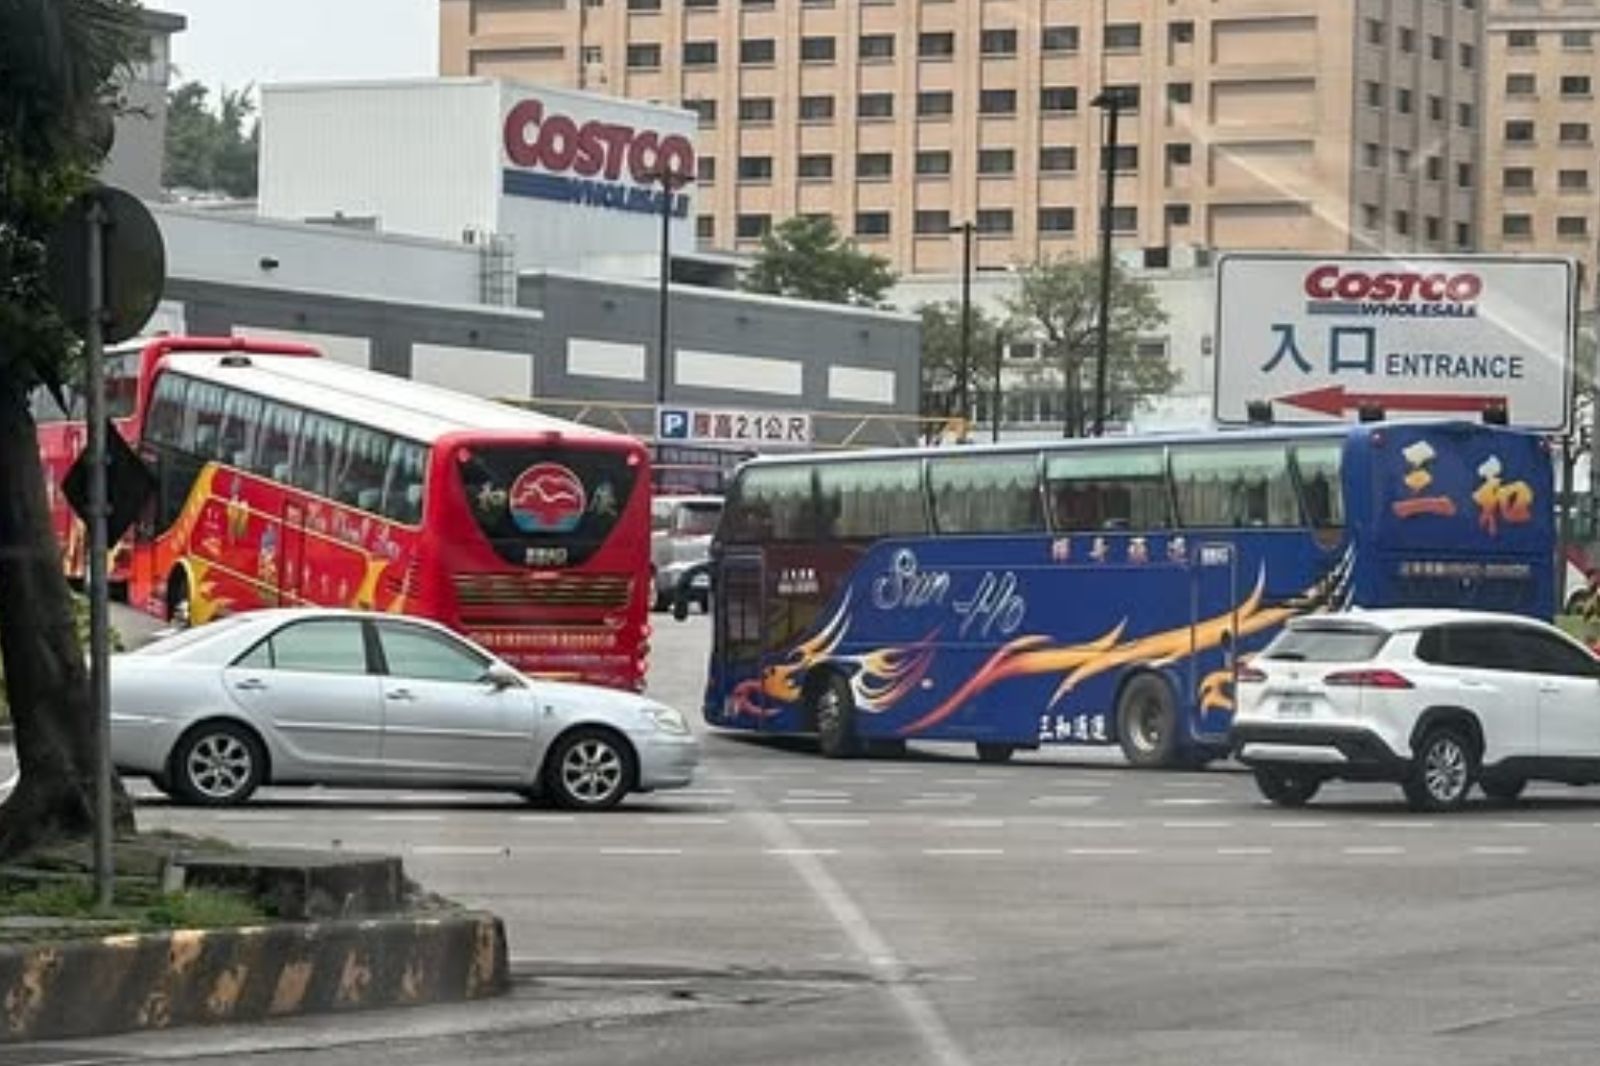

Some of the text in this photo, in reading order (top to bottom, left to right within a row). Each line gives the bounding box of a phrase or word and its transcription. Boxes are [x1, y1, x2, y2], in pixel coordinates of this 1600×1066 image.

[504, 98, 695, 190] COSTCO
[1304, 265, 1483, 301] COSTCO
[1261, 323, 1376, 375] 入口
[1385, 353, 1524, 378] ENTRANCE
[1391, 440, 1534, 537] 三和
